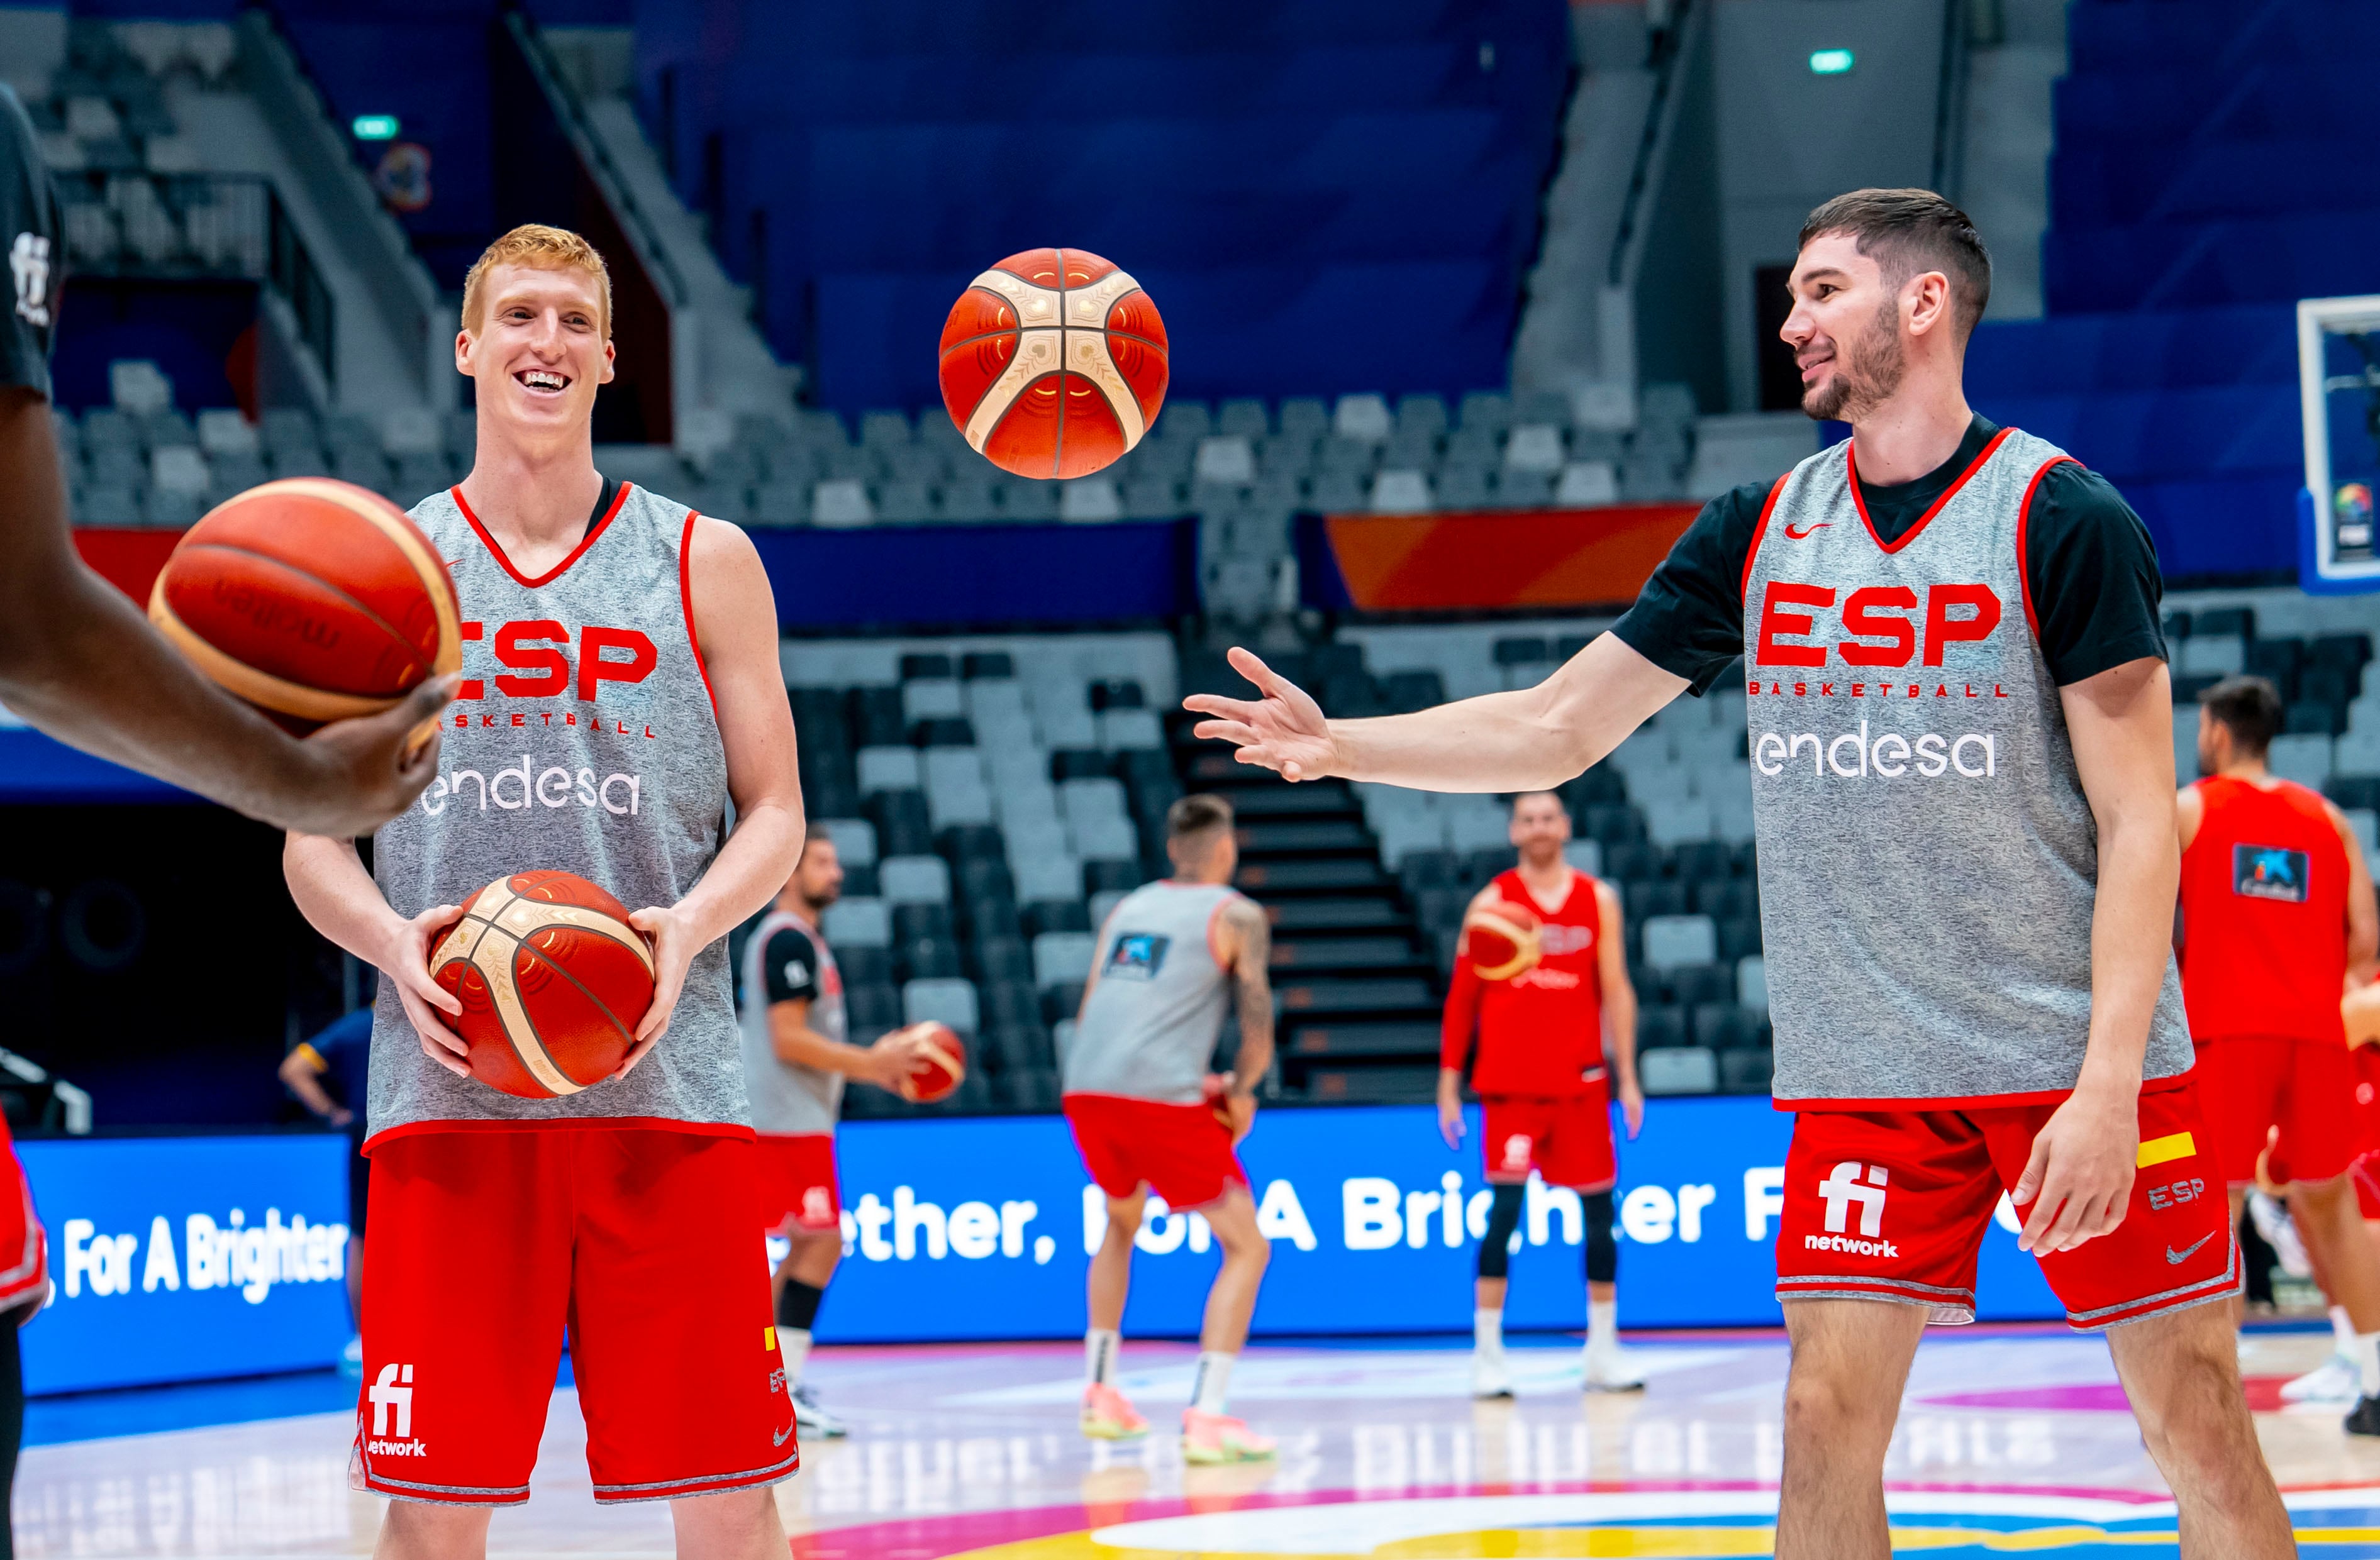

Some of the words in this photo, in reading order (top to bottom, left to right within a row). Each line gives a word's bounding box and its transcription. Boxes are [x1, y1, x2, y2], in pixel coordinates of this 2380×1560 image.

[1755, 580, 2001, 668] ESP
[1748, 682, 2008, 699] BASKETBALL
[1755, 719, 1995, 778] endesa
[420, 755, 640, 816] endesa
[1255, 1178, 1318, 1252] A
[1818, 1161, 1889, 1238] fi
[2147, 1177, 2205, 1210] ESP
[64, 1219, 138, 1298] For
[143, 1215, 181, 1293] A
[187, 1207, 350, 1305] Brighter
[1804, 1234, 1899, 1258] network
[369, 1363, 413, 1438] fi
